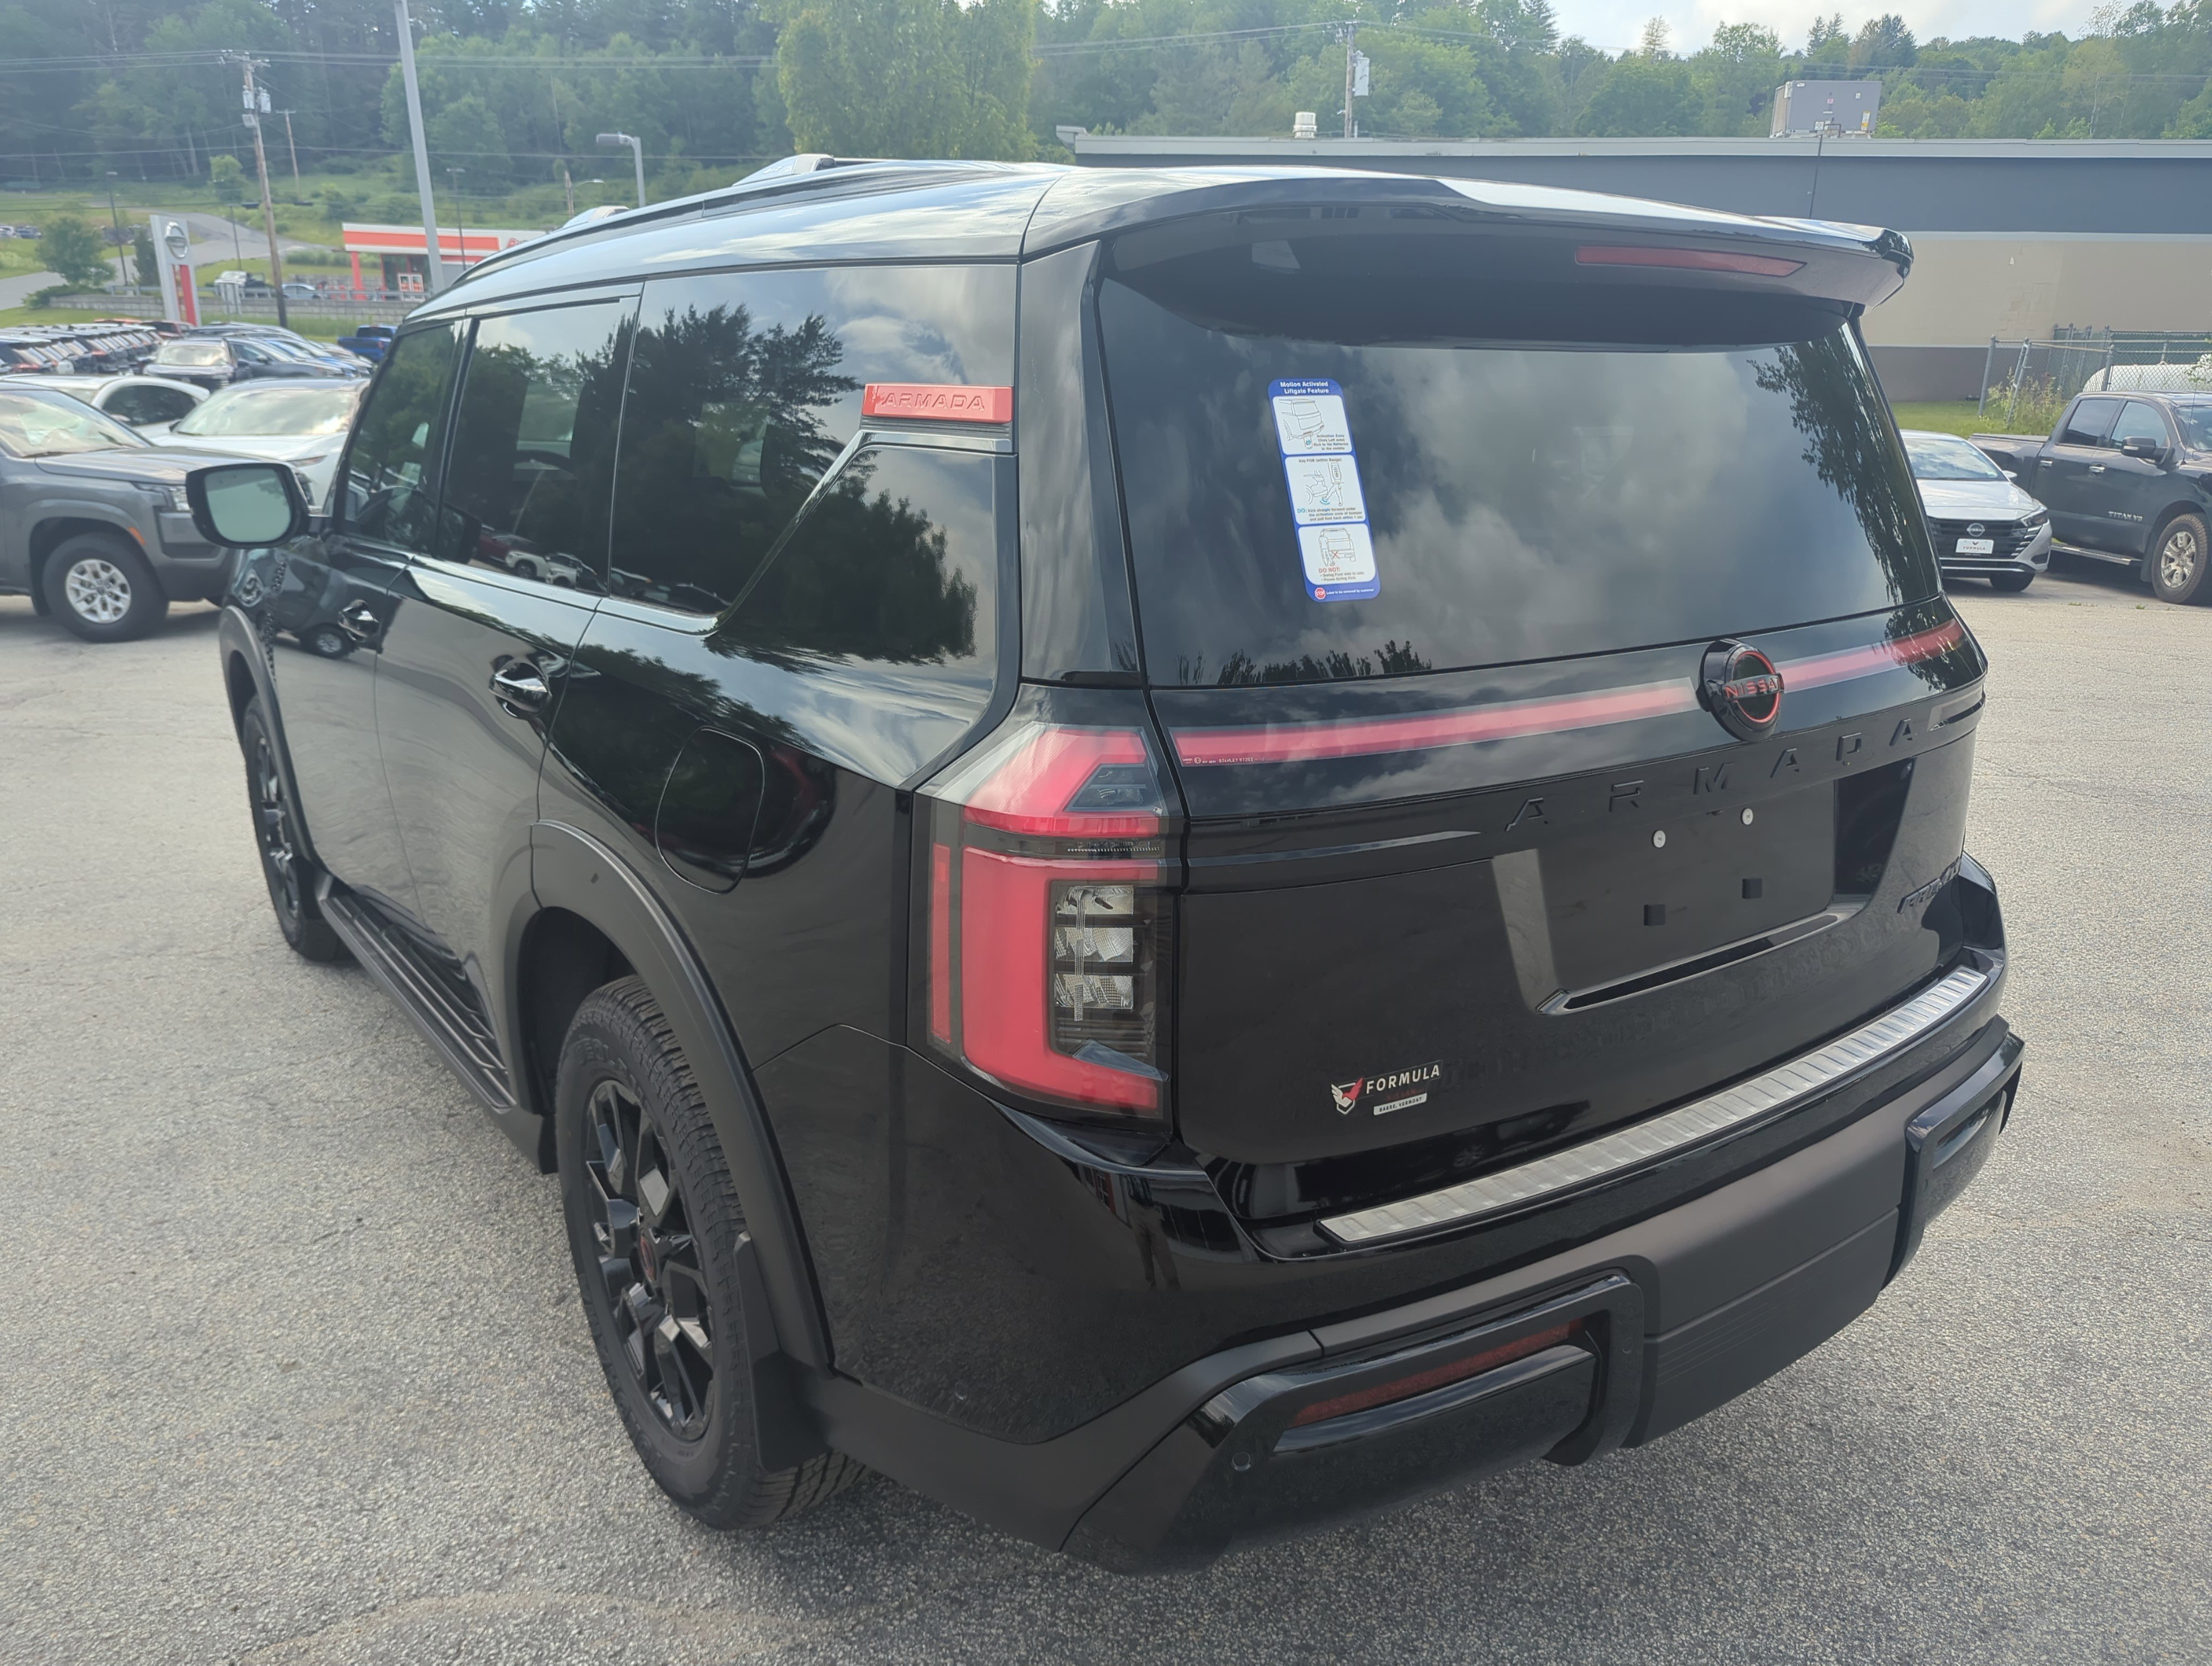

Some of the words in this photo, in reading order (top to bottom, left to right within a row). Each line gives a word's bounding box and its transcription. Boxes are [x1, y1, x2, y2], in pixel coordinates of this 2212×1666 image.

[881, 393, 985, 412] ARMADA
[2108, 511, 2132, 521] TITAN
[1725, 676, 1784, 699] NISSAN
[1505, 717, 1916, 832] ARMADA
[1366, 1064, 1439, 1094] FORMULA
[1398, 1097, 1422, 1108] VERMONT
